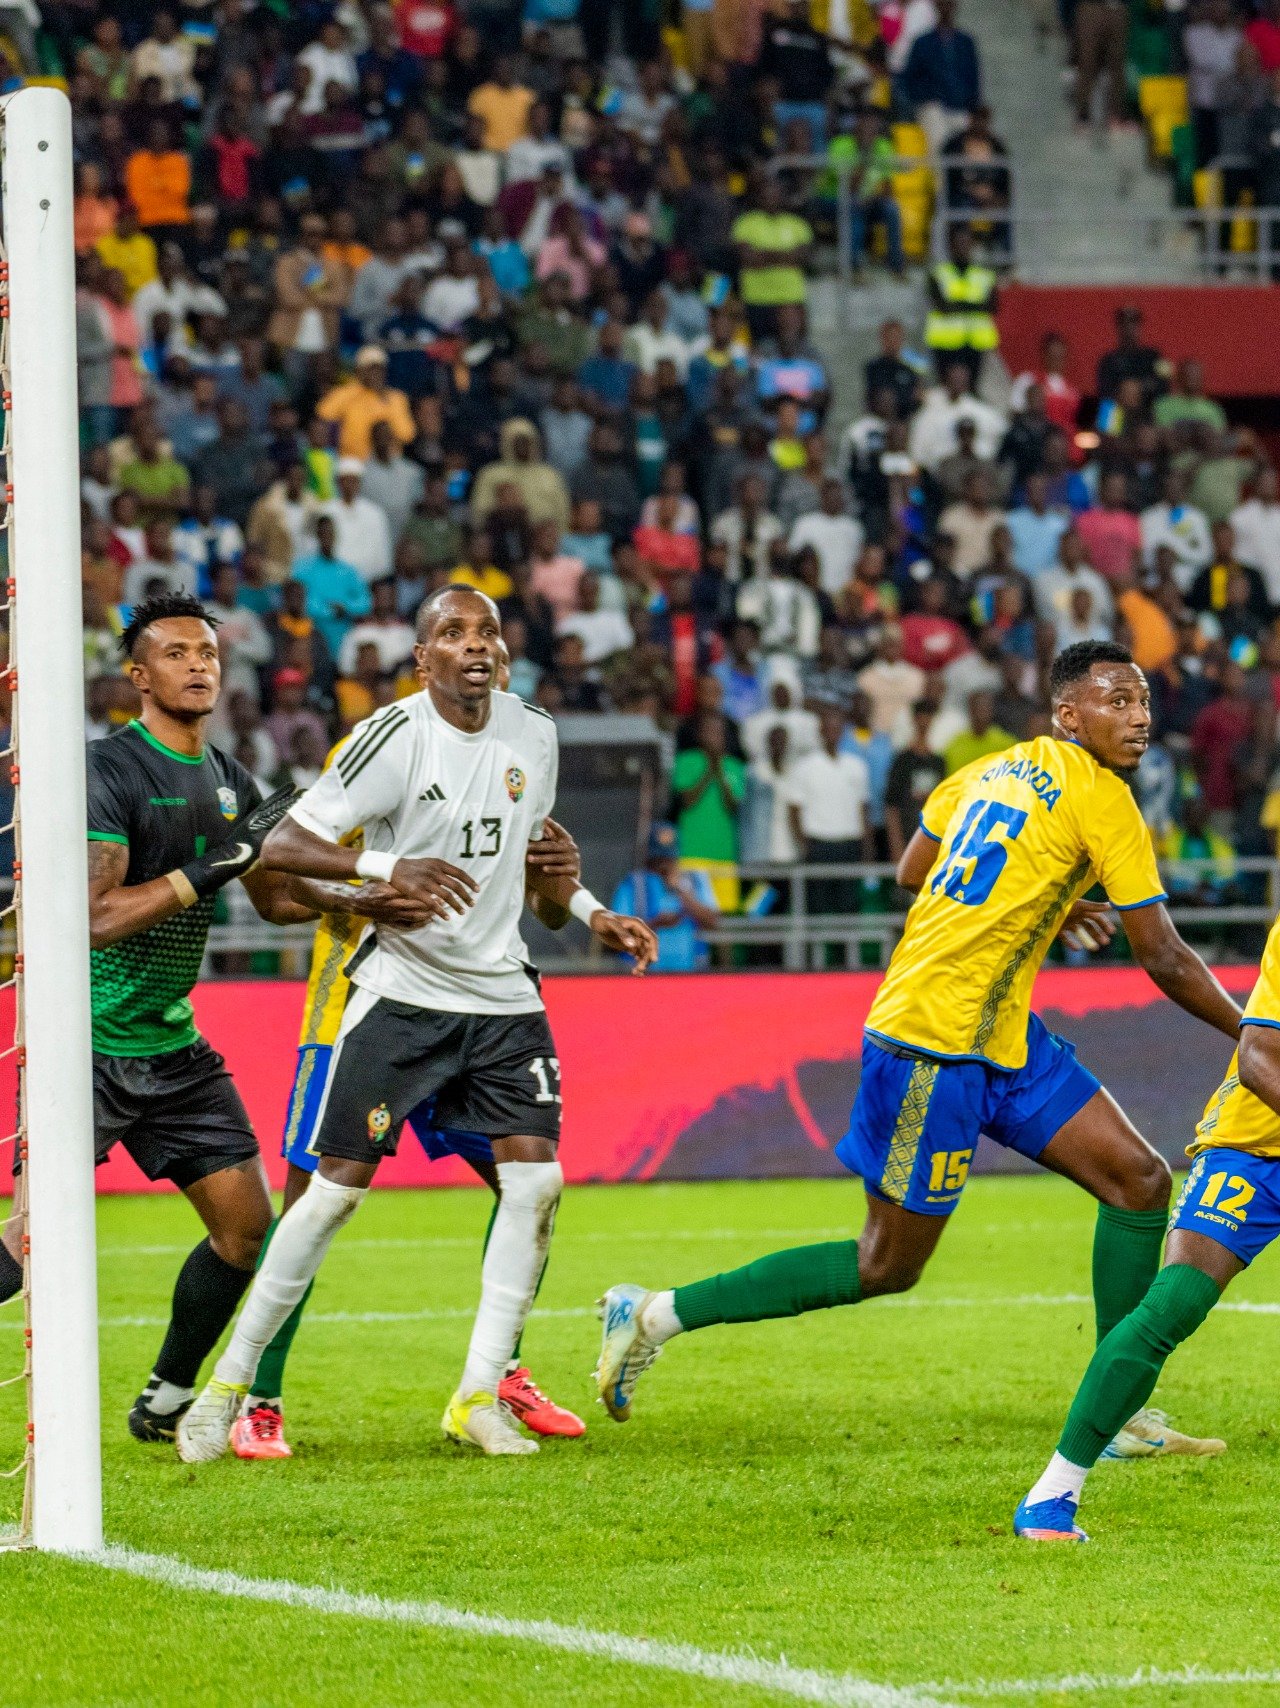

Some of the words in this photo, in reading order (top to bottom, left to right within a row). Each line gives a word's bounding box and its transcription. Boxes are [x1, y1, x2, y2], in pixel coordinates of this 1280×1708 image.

[459, 817, 502, 859] 13
[931, 798, 1030, 907] 15
[928, 1148, 973, 1192] 15
[1198, 1171, 1257, 1223] 12
